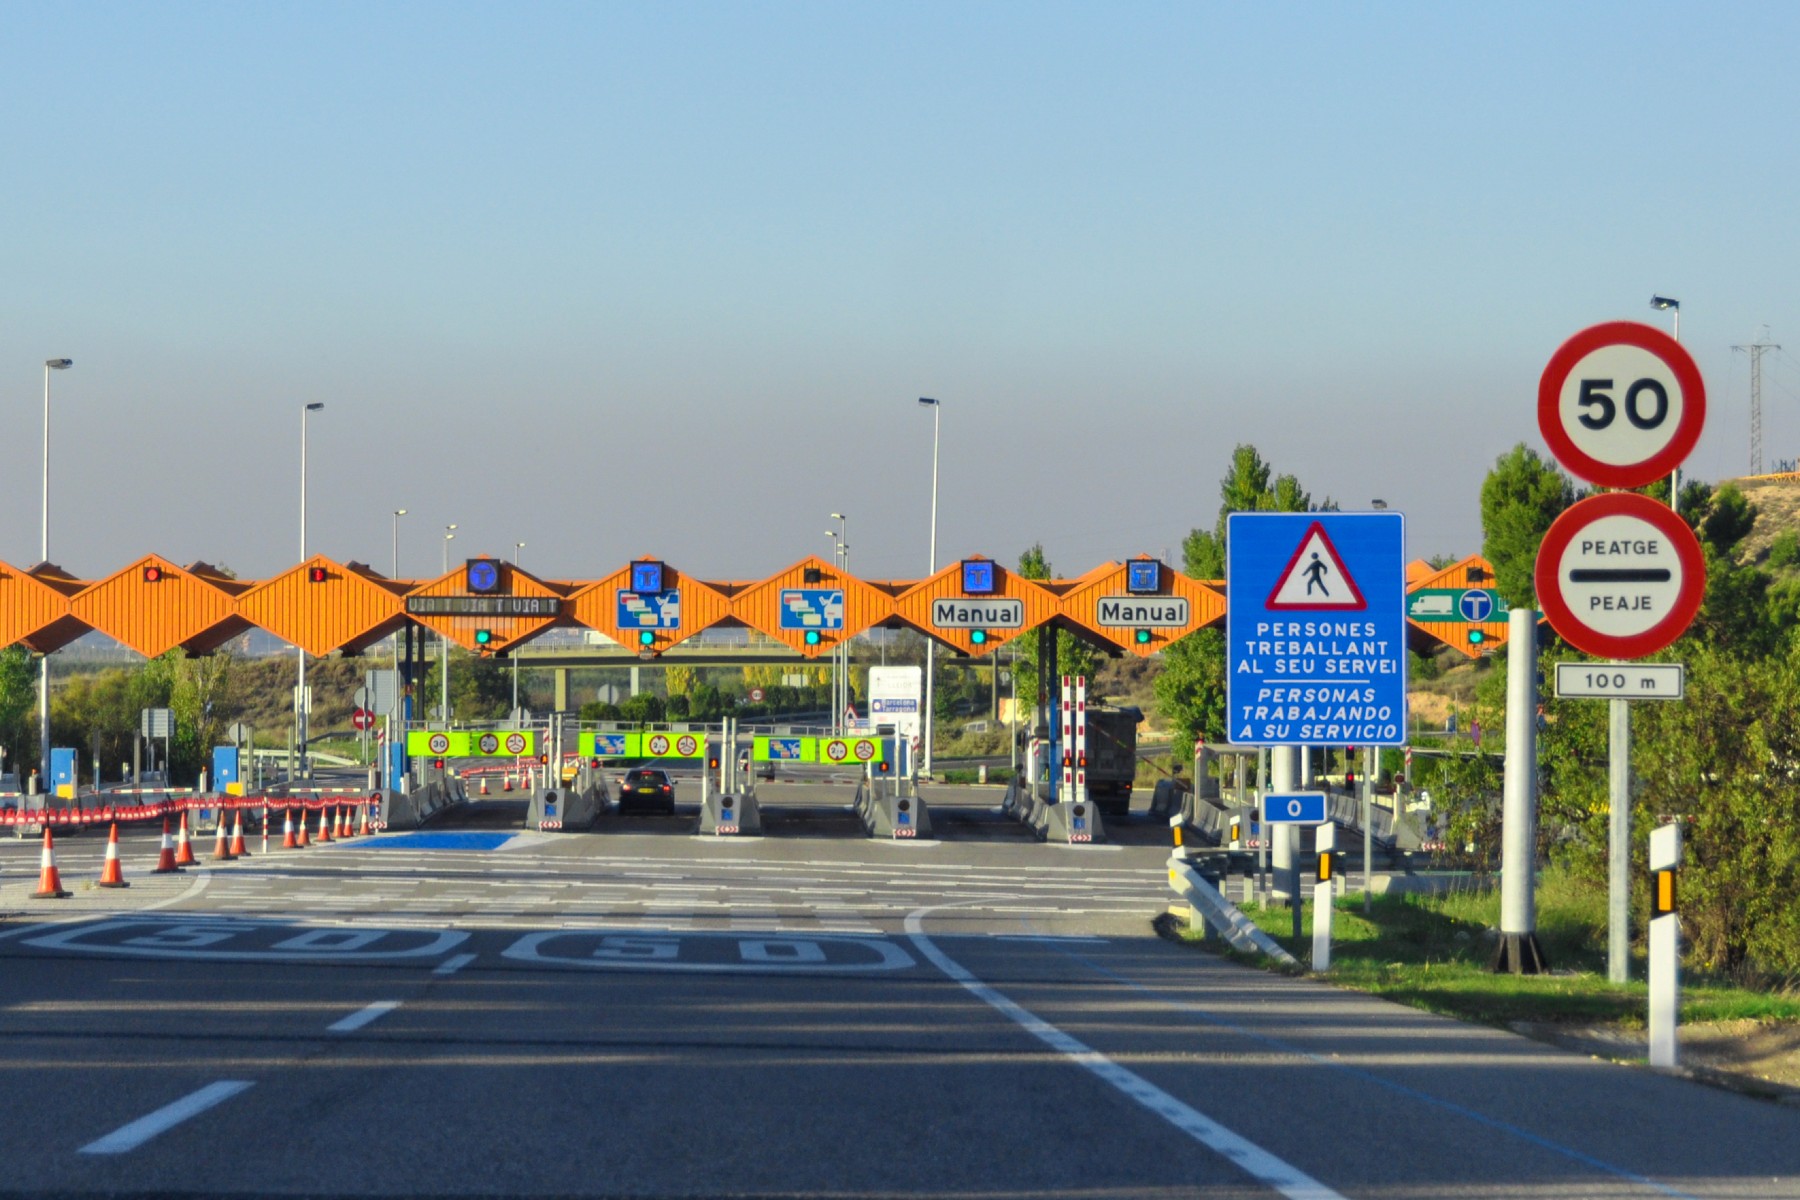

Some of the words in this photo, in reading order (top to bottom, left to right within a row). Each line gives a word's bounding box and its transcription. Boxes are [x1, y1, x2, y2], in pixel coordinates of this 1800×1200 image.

[1577, 378, 1669, 430] 50
[1582, 540, 1659, 555] PEATGE
[1590, 596, 1652, 611] PEAJE
[937, 604, 1018, 623] Manual
[1102, 602, 1184, 621] Manual
[1257, 623, 1376, 637] PERSONES
[1246, 641, 1388, 655] TREBALLANT
[1237, 660, 1264, 674] AL
[1275, 660, 1315, 674] SEU
[1325, 659, 1397, 674] SERVEI
[1585, 673, 1625, 688] 100
[1641, 678, 1655, 689] m
[1258, 688, 1376, 703] PERSONAS
[1243, 706, 1391, 721] TRABAJANDO
[1239, 725, 1253, 738] A
[1263, 725, 1290, 739] SU
[1300, 725, 1397, 739] SERVICIO
[433, 740, 446, 748] 30
